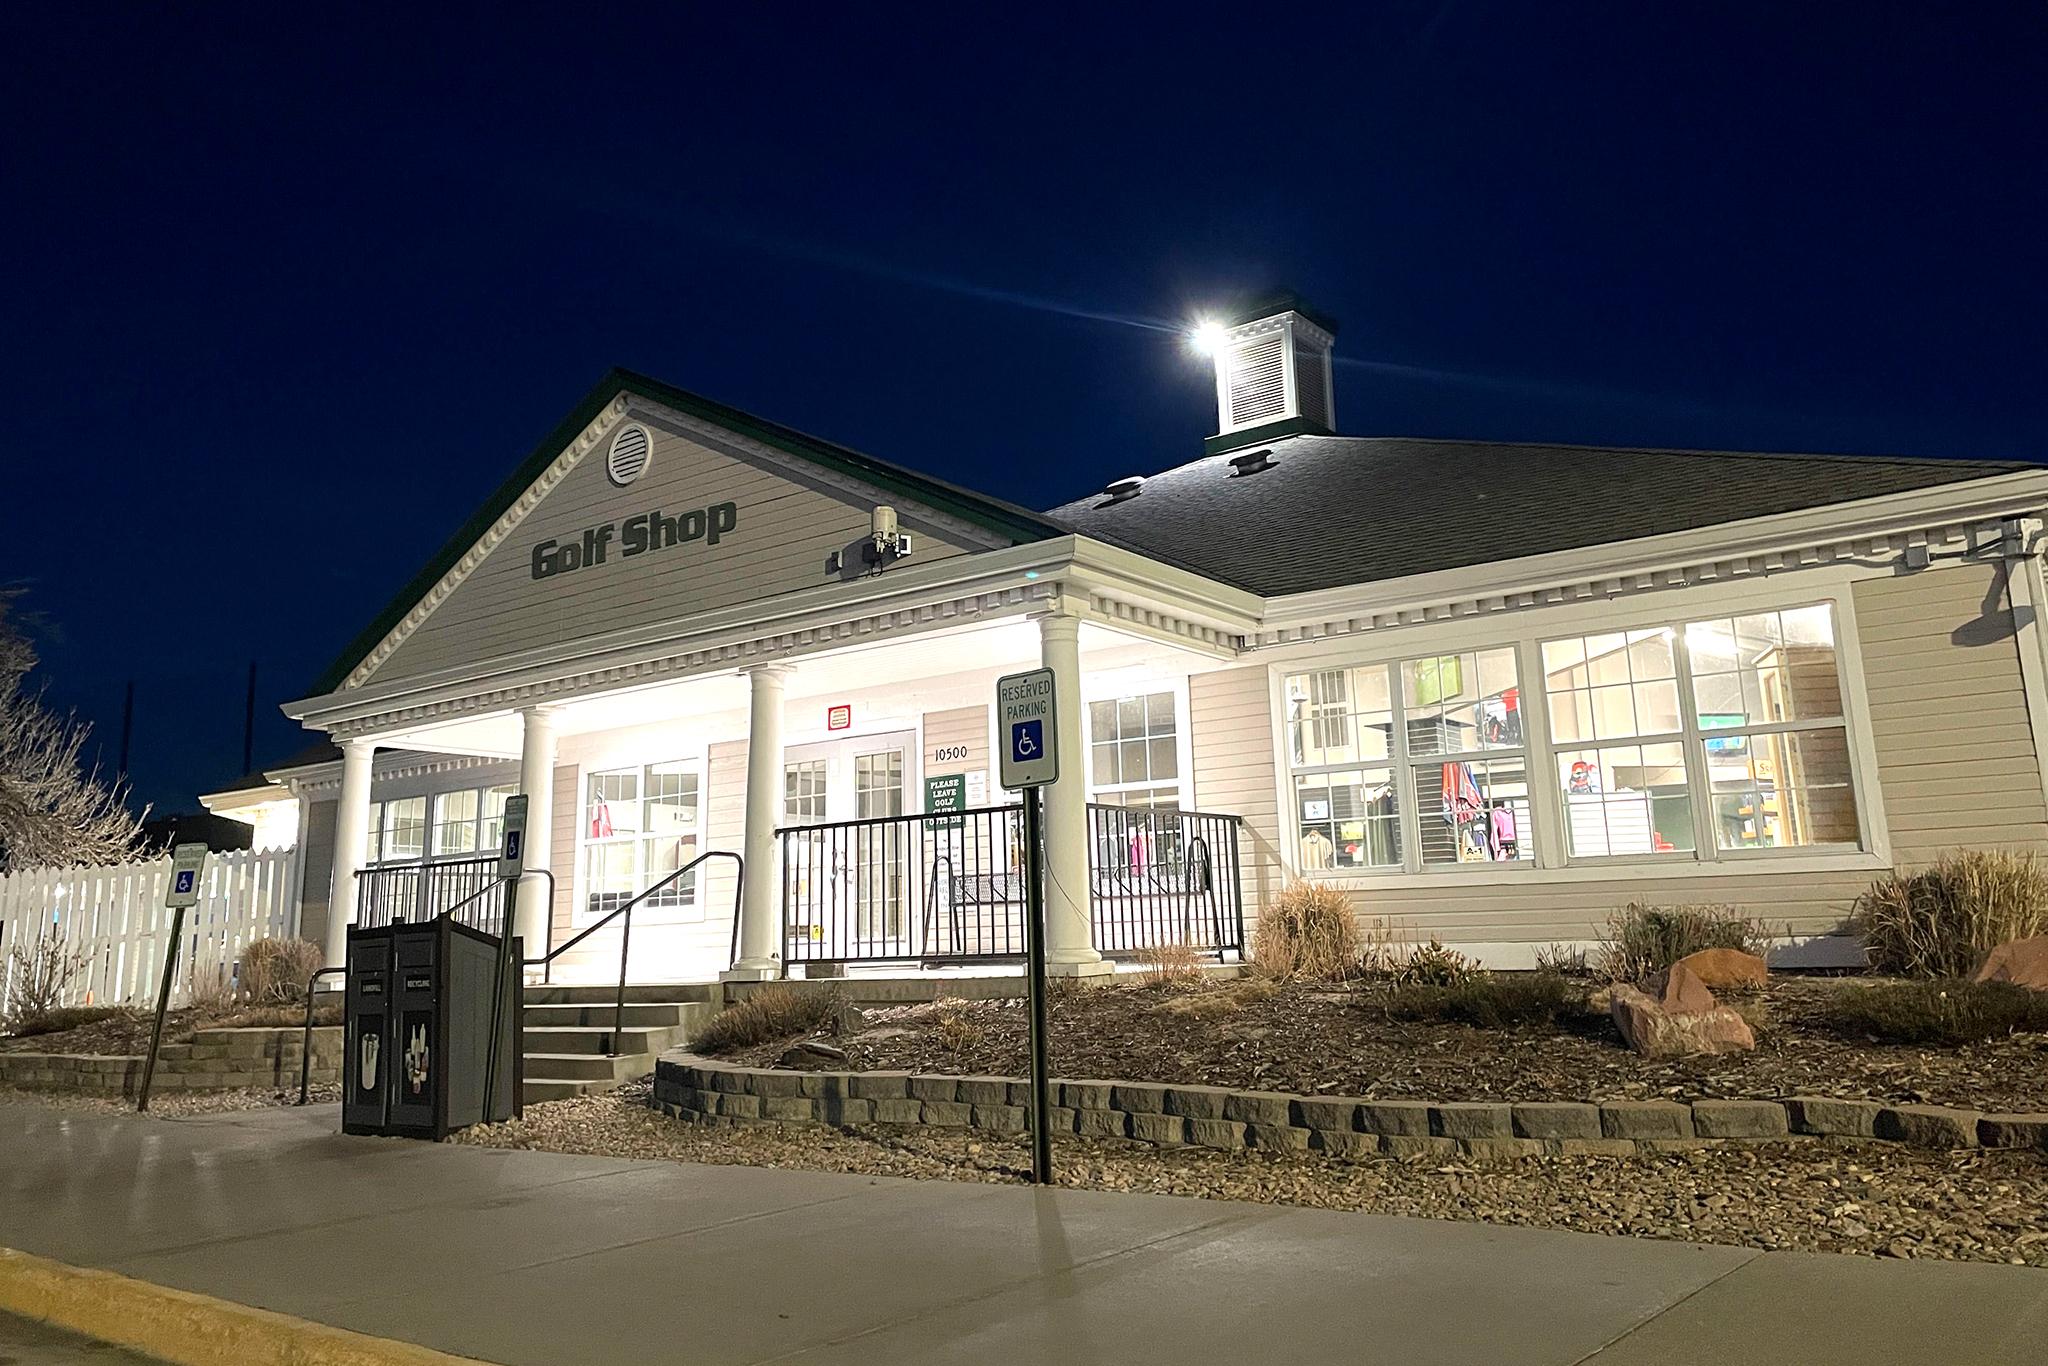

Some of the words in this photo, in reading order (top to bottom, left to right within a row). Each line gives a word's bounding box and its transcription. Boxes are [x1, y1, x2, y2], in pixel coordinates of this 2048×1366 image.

[532, 523, 615, 580] Golf
[621, 501, 737, 557] Shop
[1001, 679, 1051, 704] RESERVED
[1007, 700, 1047, 720] PARKING
[935, 746, 967, 762] 10500
[930, 779, 960, 790] PLEASE
[932, 789, 957, 798] LEAVE
[935, 798, 955, 807] GOLF
[929, 815, 962, 826] OUTSDE
